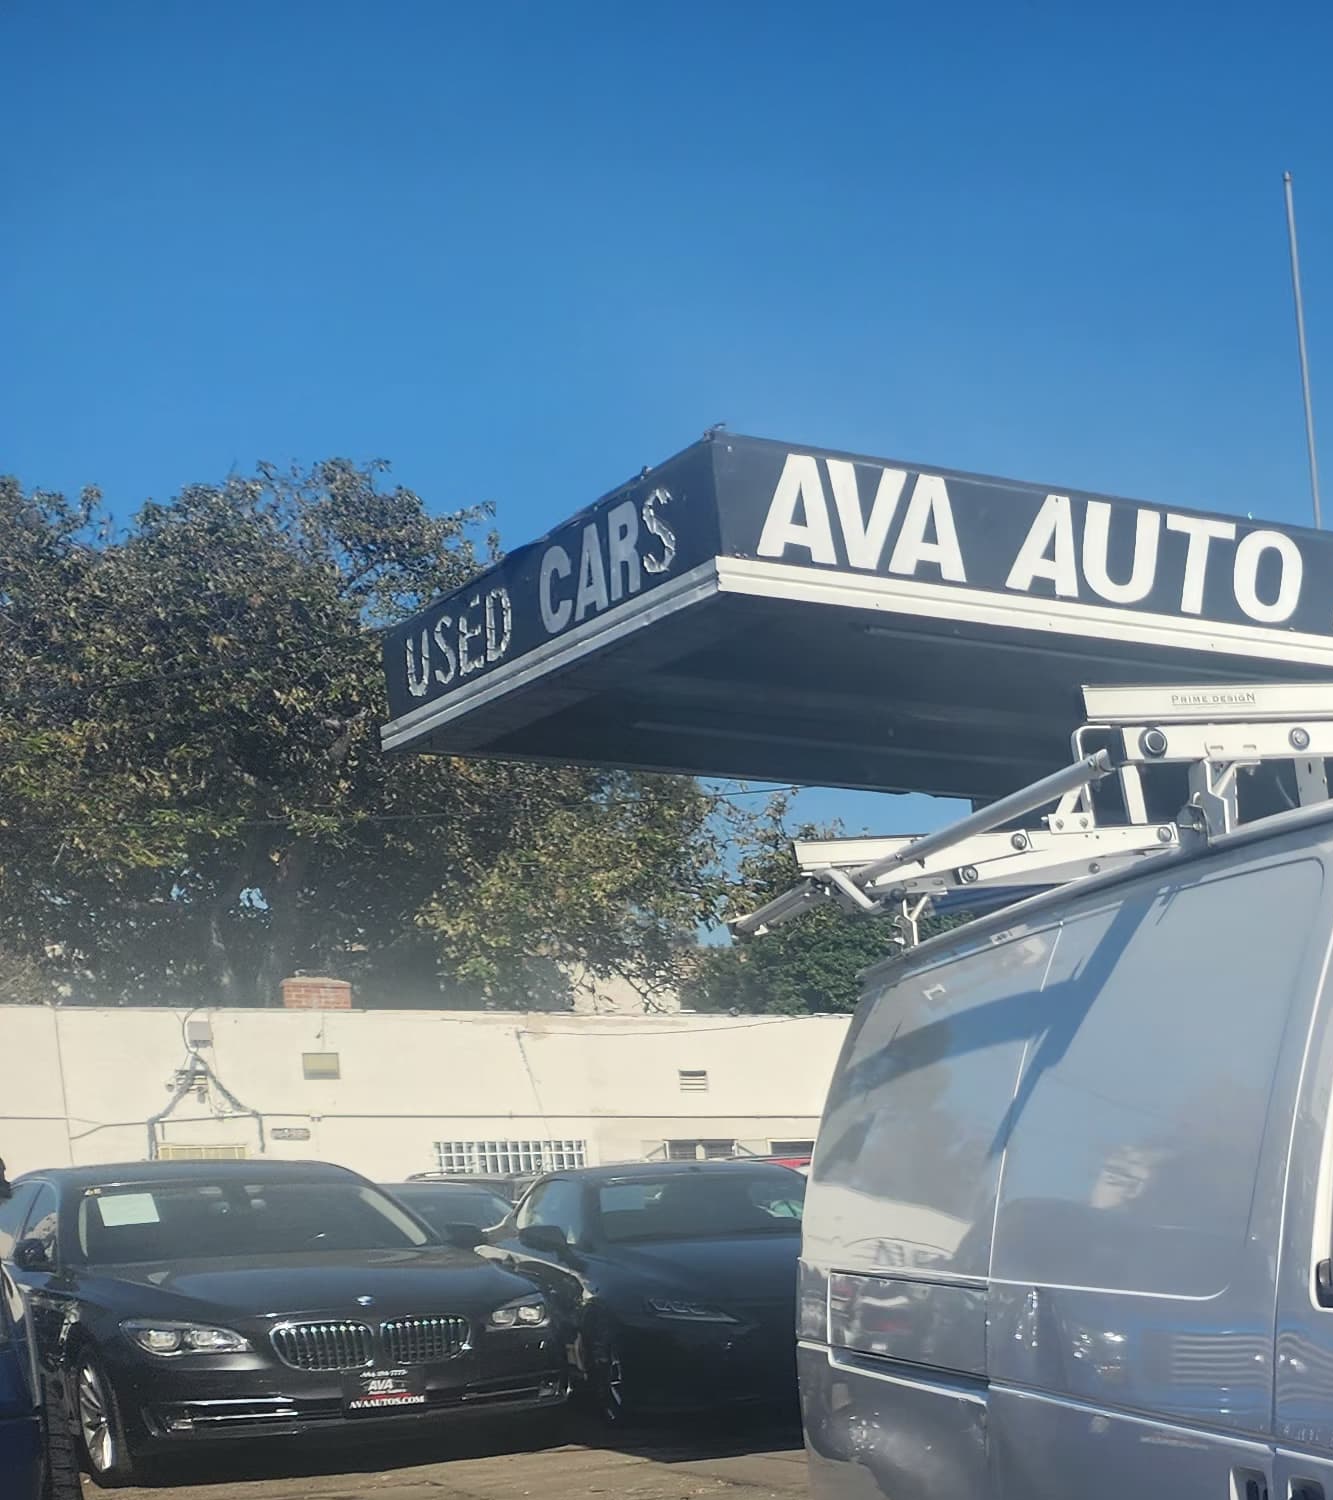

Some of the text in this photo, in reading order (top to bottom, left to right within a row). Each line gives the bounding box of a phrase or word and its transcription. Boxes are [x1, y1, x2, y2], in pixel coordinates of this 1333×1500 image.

[405, 487, 676, 697] USED CARS
[757, 453, 967, 583] AVA
[1004, 493, 1304, 623] AUTO
